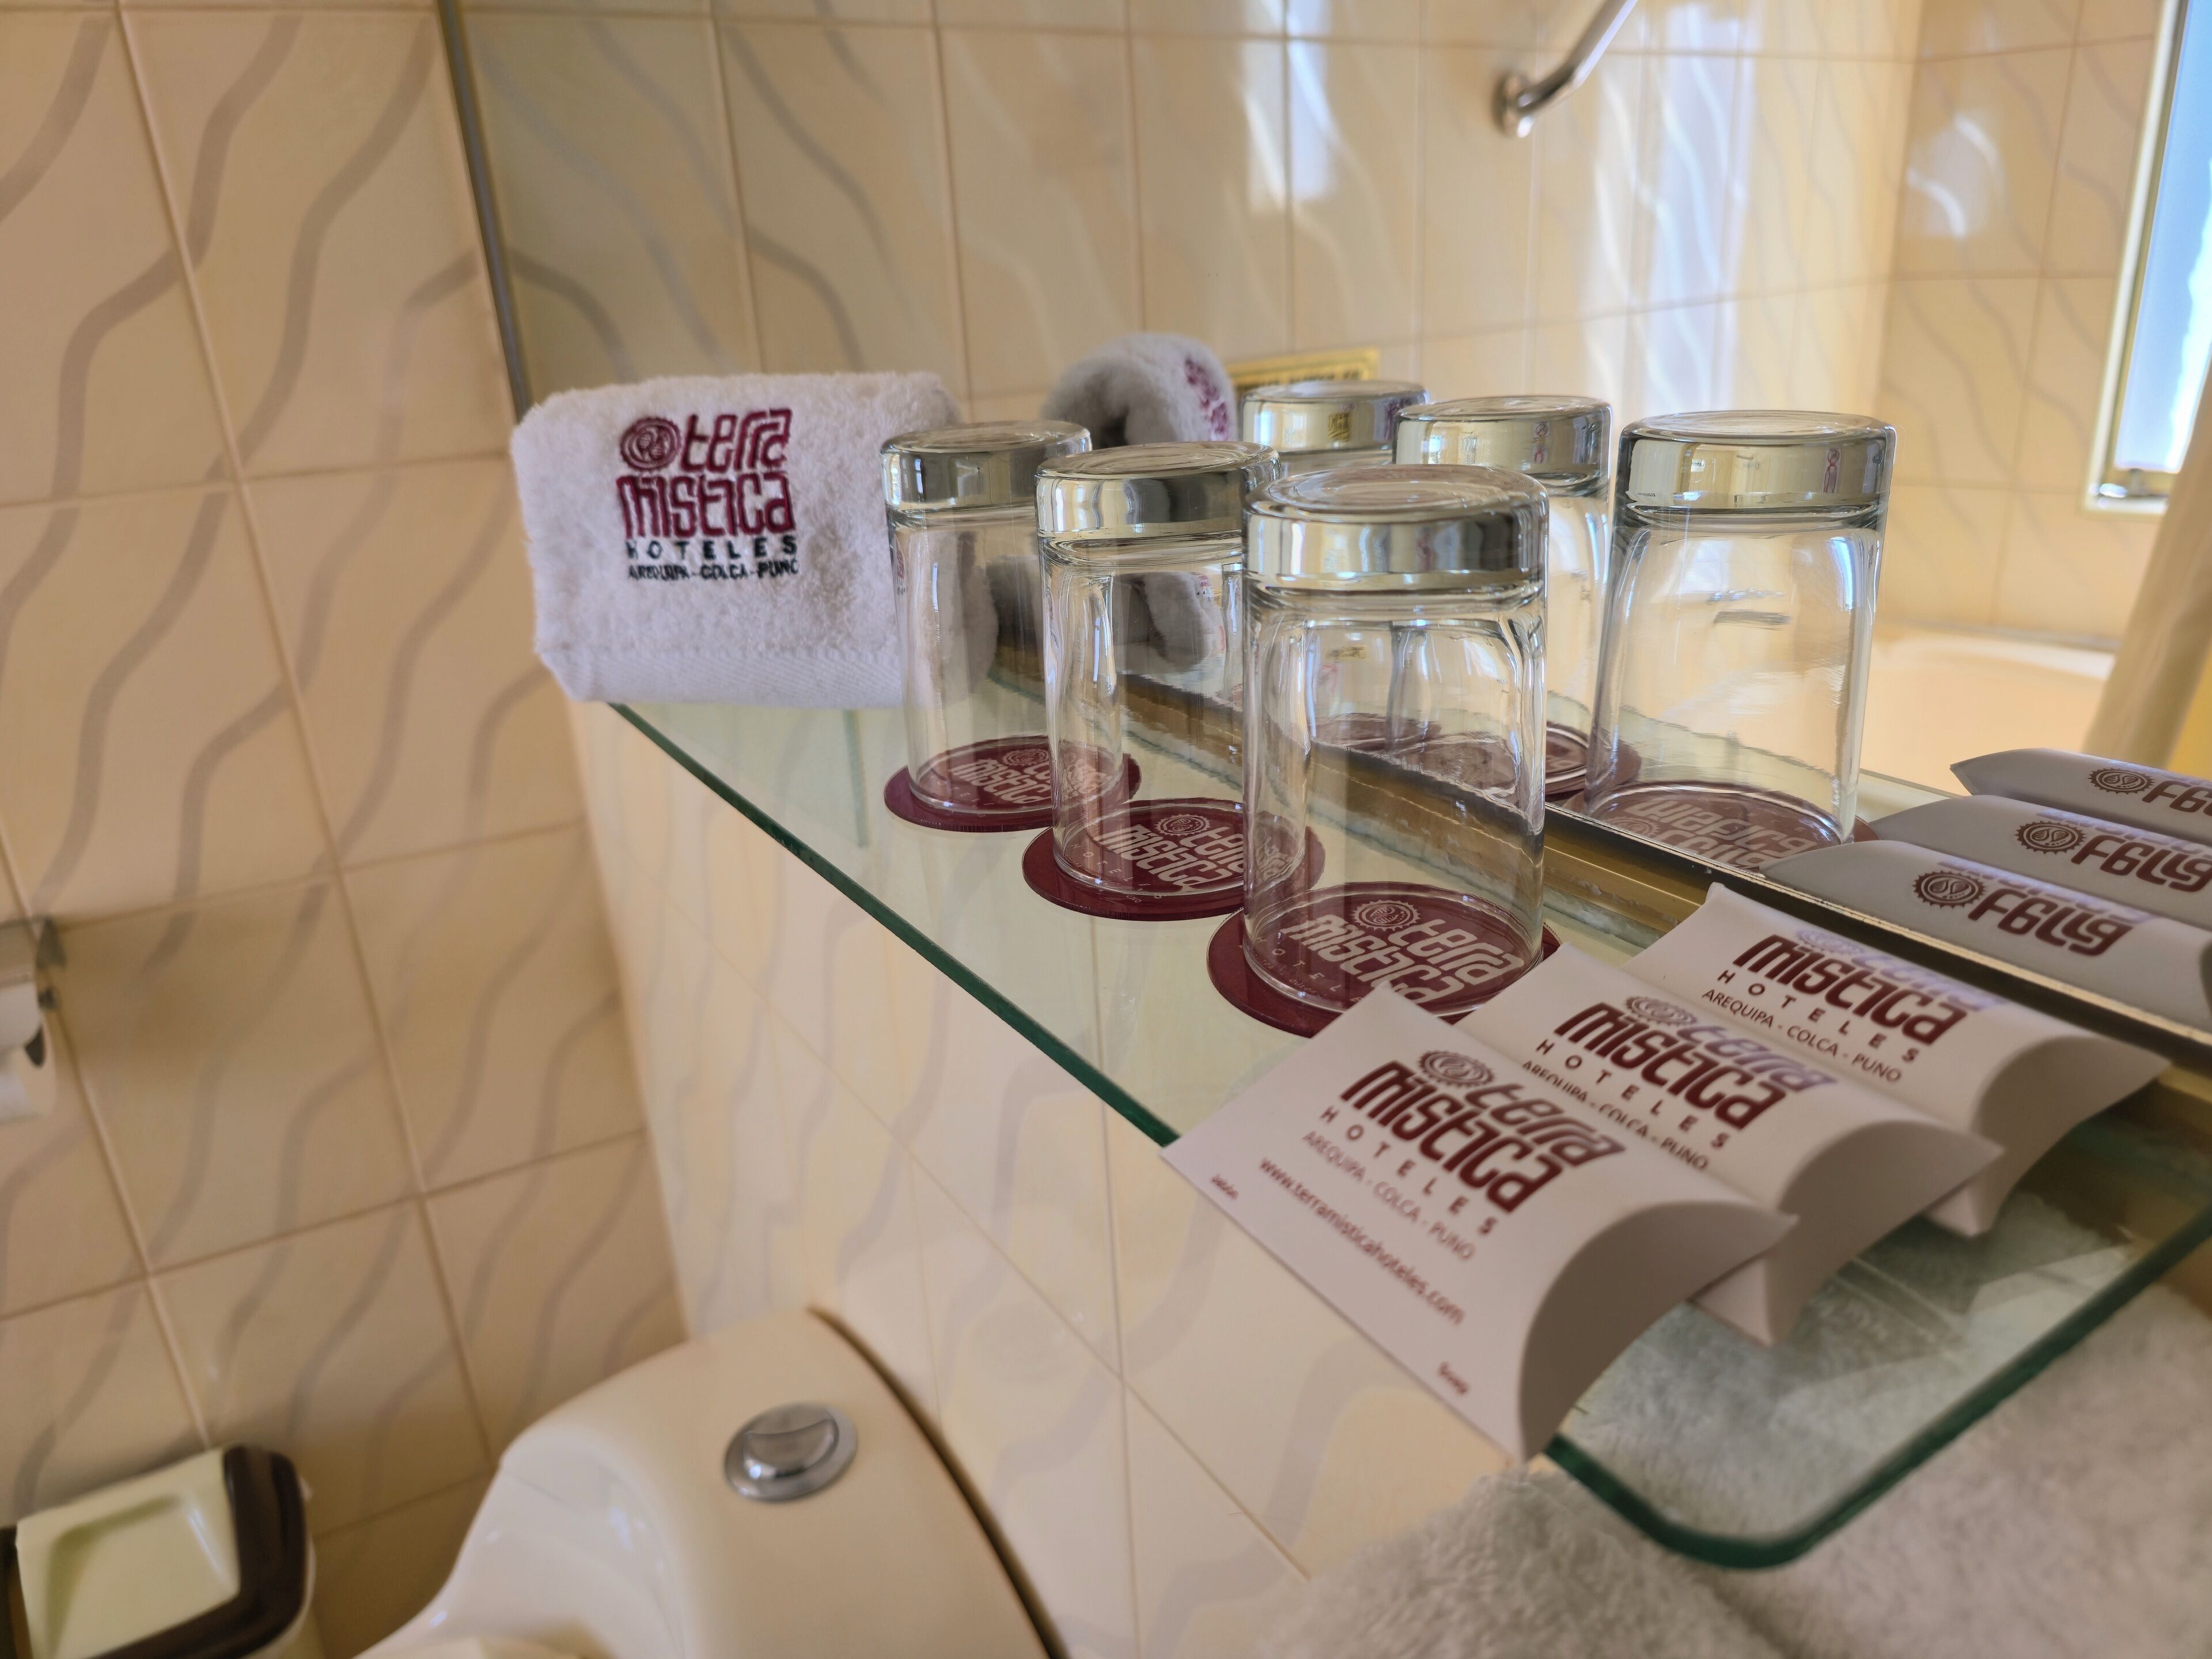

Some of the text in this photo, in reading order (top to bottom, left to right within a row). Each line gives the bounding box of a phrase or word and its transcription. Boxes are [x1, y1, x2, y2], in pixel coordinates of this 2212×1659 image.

[681, 408, 792, 472] terra
[616, 471, 796, 539] mistica
[626, 535, 798, 561] HOTELES
[1388, 919, 1525, 986] terra
[1733, 934, 1968, 1046] mistica
[1554, 1001, 1786, 1130] mistica
[1702, 989, 1774, 1029] AREQUIPA
[1786, 1024, 1840, 1058] COLCA
[1851, 1053, 1903, 1083] PUNO
[1717, 969, 1921, 1063] HOTELES
[1339, 1060, 1563, 1214] mistica
[1464, 1083, 1627, 1167] terra
[1522, 1059, 1588, 1103] AREQUIPA
[1599, 1101, 1649, 1139] COLCA
[1660, 1137, 1709, 1171] PUNO
[1535, 1039, 1730, 1149] HOTELES
[1302, 1130, 1366, 1181] AREQUIPA
[1373, 1180, 1421, 1222] COLCA
[1427, 1221, 1476, 1261] PUNO
[1320, 1105, 1498, 1236] HOTELES
